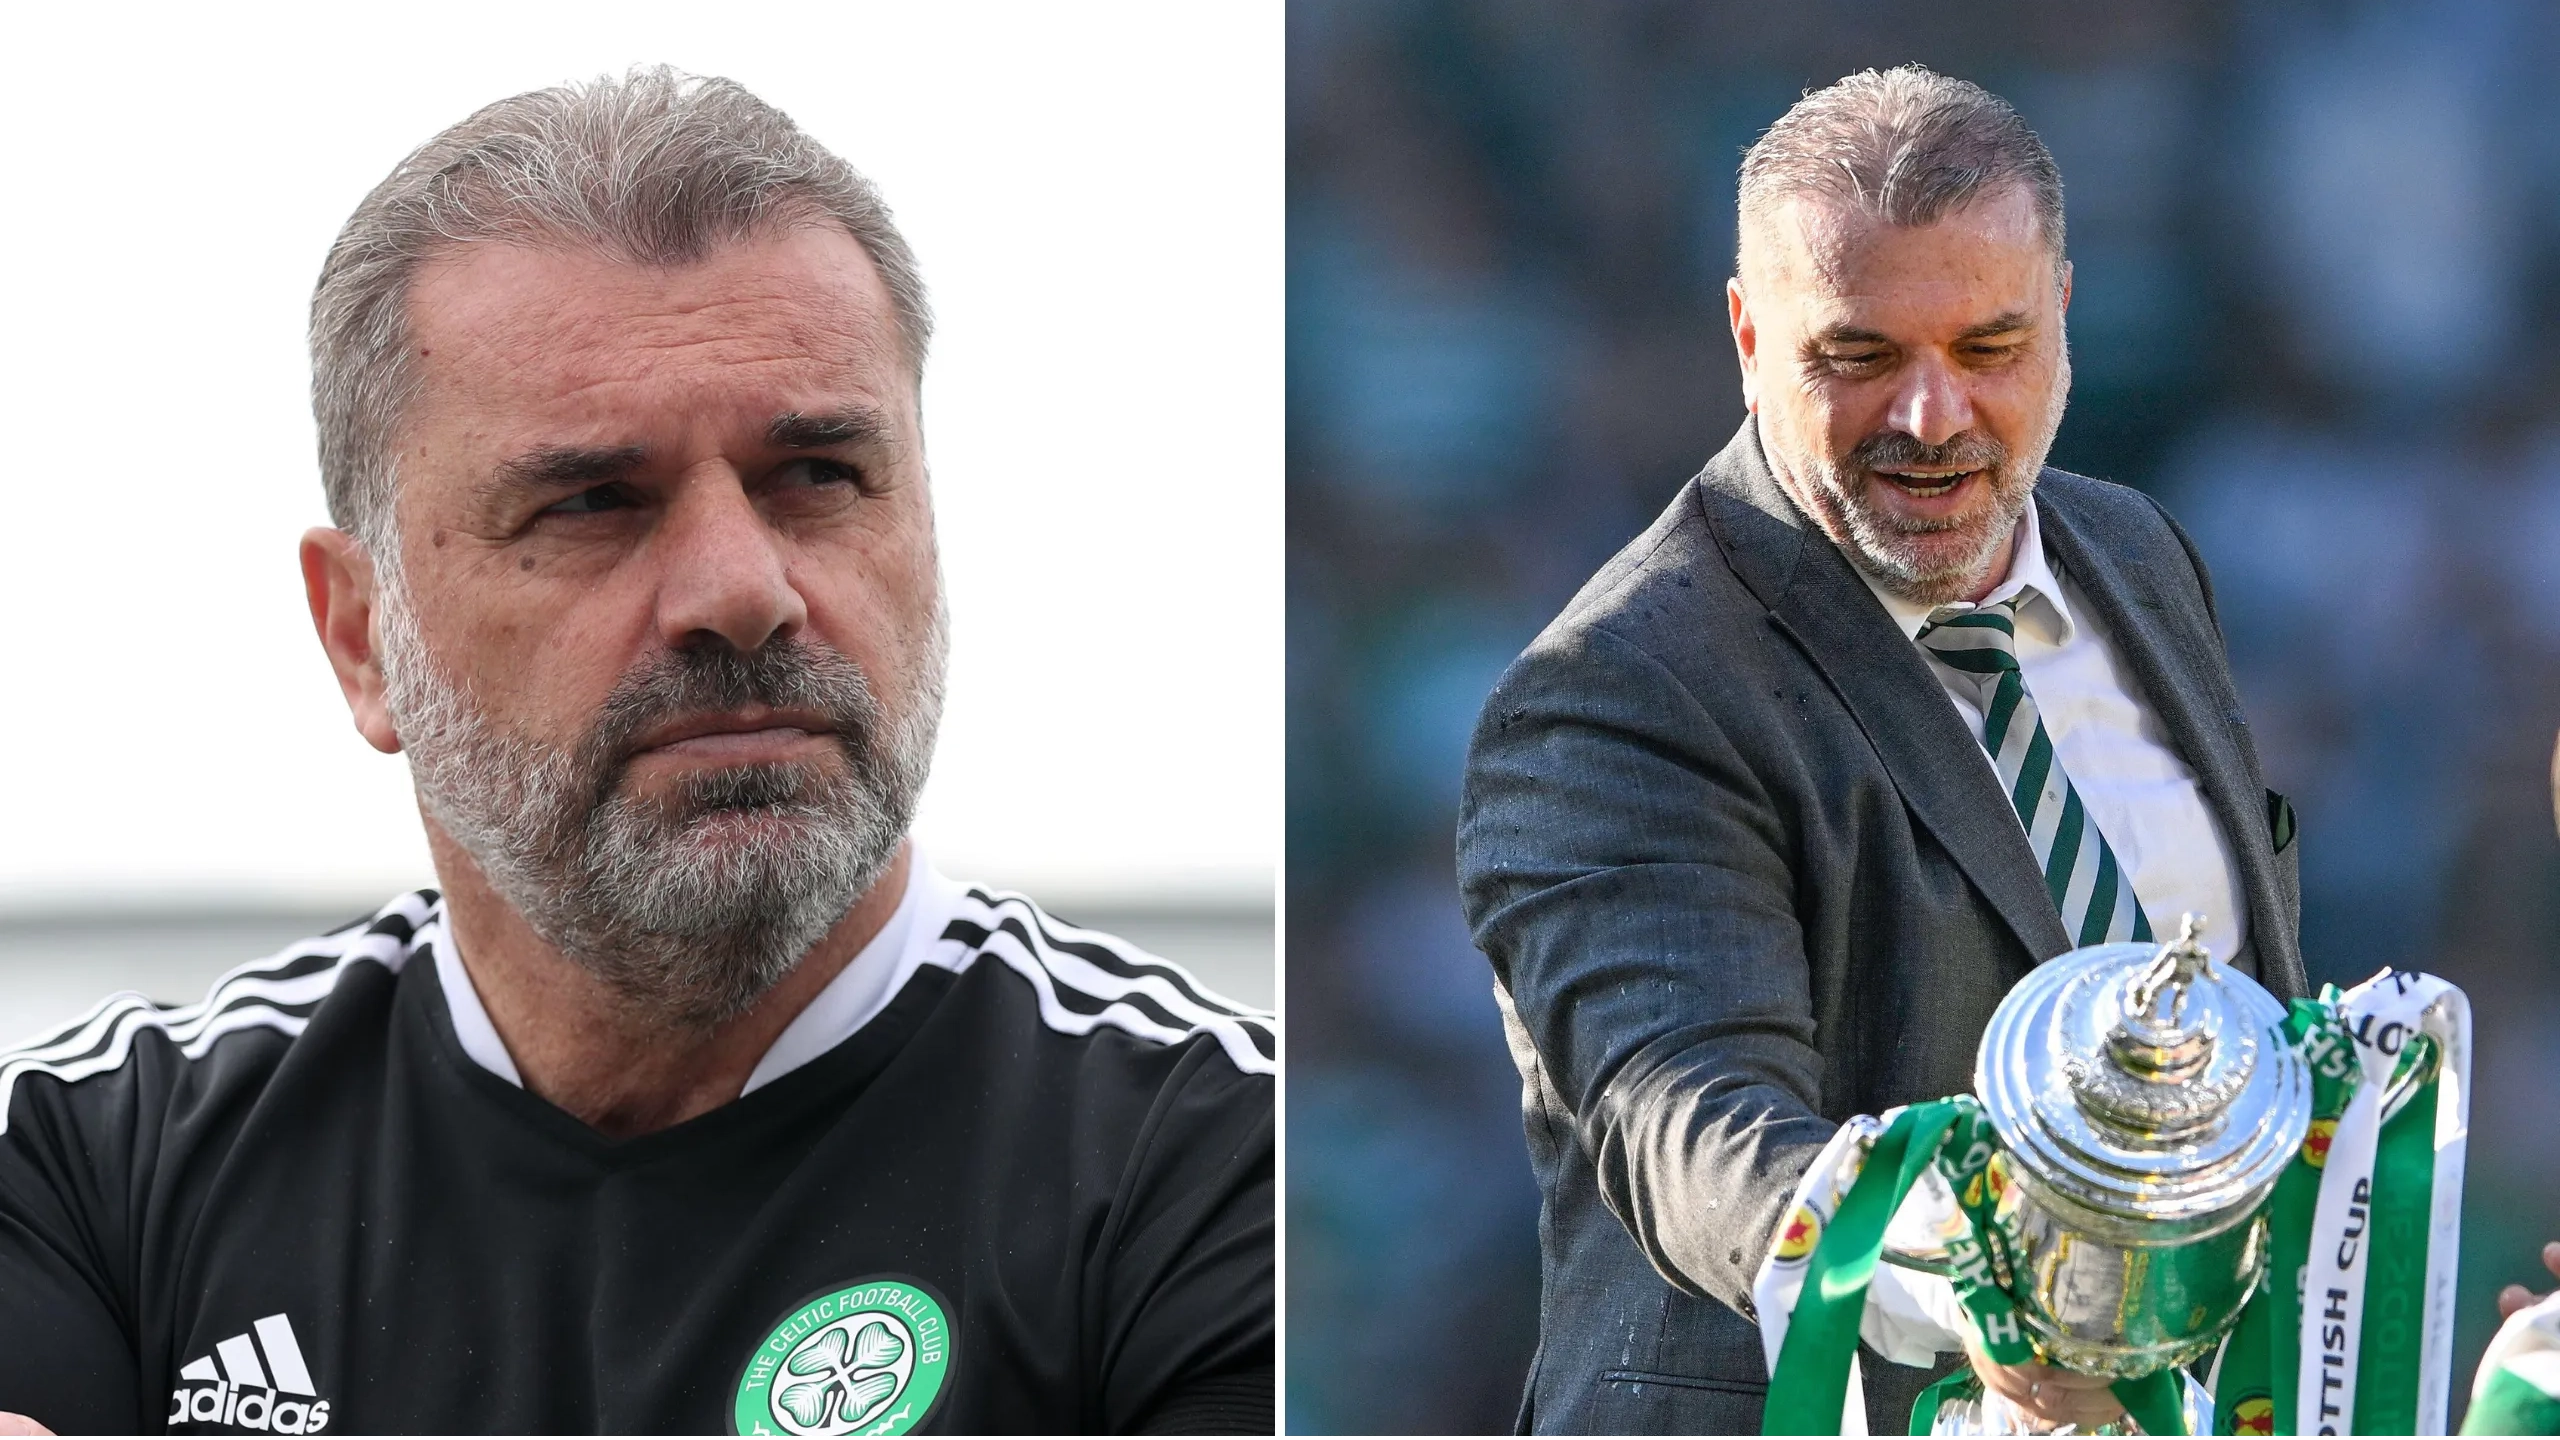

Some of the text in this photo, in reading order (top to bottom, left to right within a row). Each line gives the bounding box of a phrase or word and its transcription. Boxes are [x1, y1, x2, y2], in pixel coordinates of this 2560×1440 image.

[2338, 1176, 2371, 1270] CUP
[745, 1287, 942, 1392] THE CELTIC FOOTBALL CLUB
[168, 1379, 331, 1436] adidas
